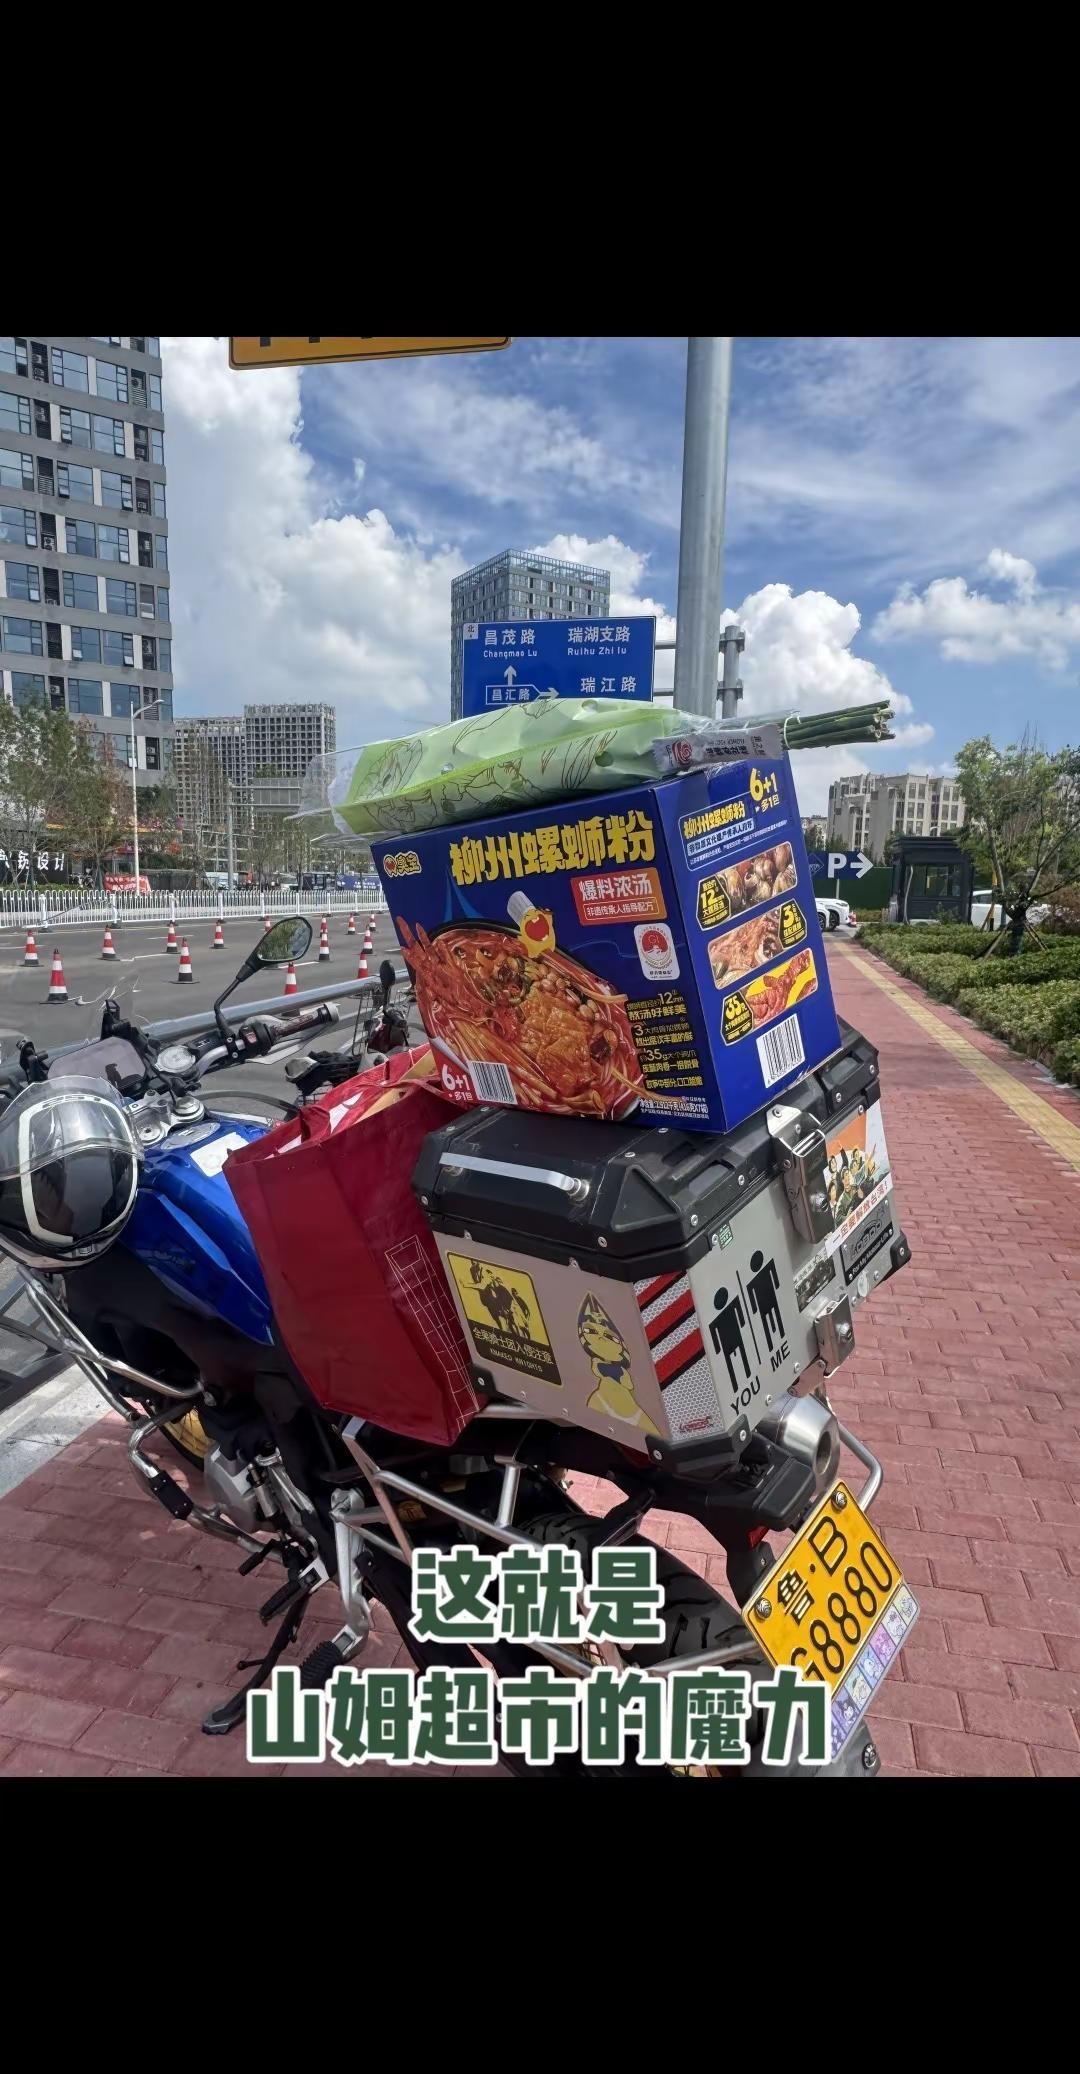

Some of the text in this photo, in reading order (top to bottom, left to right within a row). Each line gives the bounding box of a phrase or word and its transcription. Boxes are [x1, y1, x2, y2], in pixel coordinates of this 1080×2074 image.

[467, 624, 475, 633] 北
[484, 629, 536, 646] 昌茂路
[567, 625, 631, 644] 瑞湖支路
[483, 649, 538, 660] Changmao Lu
[567, 647, 596, 656] Ruihu
[599, 646, 614, 655] Zhi
[580, 675, 637, 694] 瑞江路
[492, 688, 531, 702] 昌汇路
[761, 794, 780, 813] 多1包
[683, 801, 746, 840] 柳州螺蛳粉
[449, 810, 657, 886] 柳州螺蛳粉
[828, 852, 848, 878] P
[578, 873, 653, 902] 爆料浓汤
[770, 1340, 790, 1371] ME
[731, 1376, 760, 1415] YOU
[778, 1516, 848, 1625] 鲁·B
